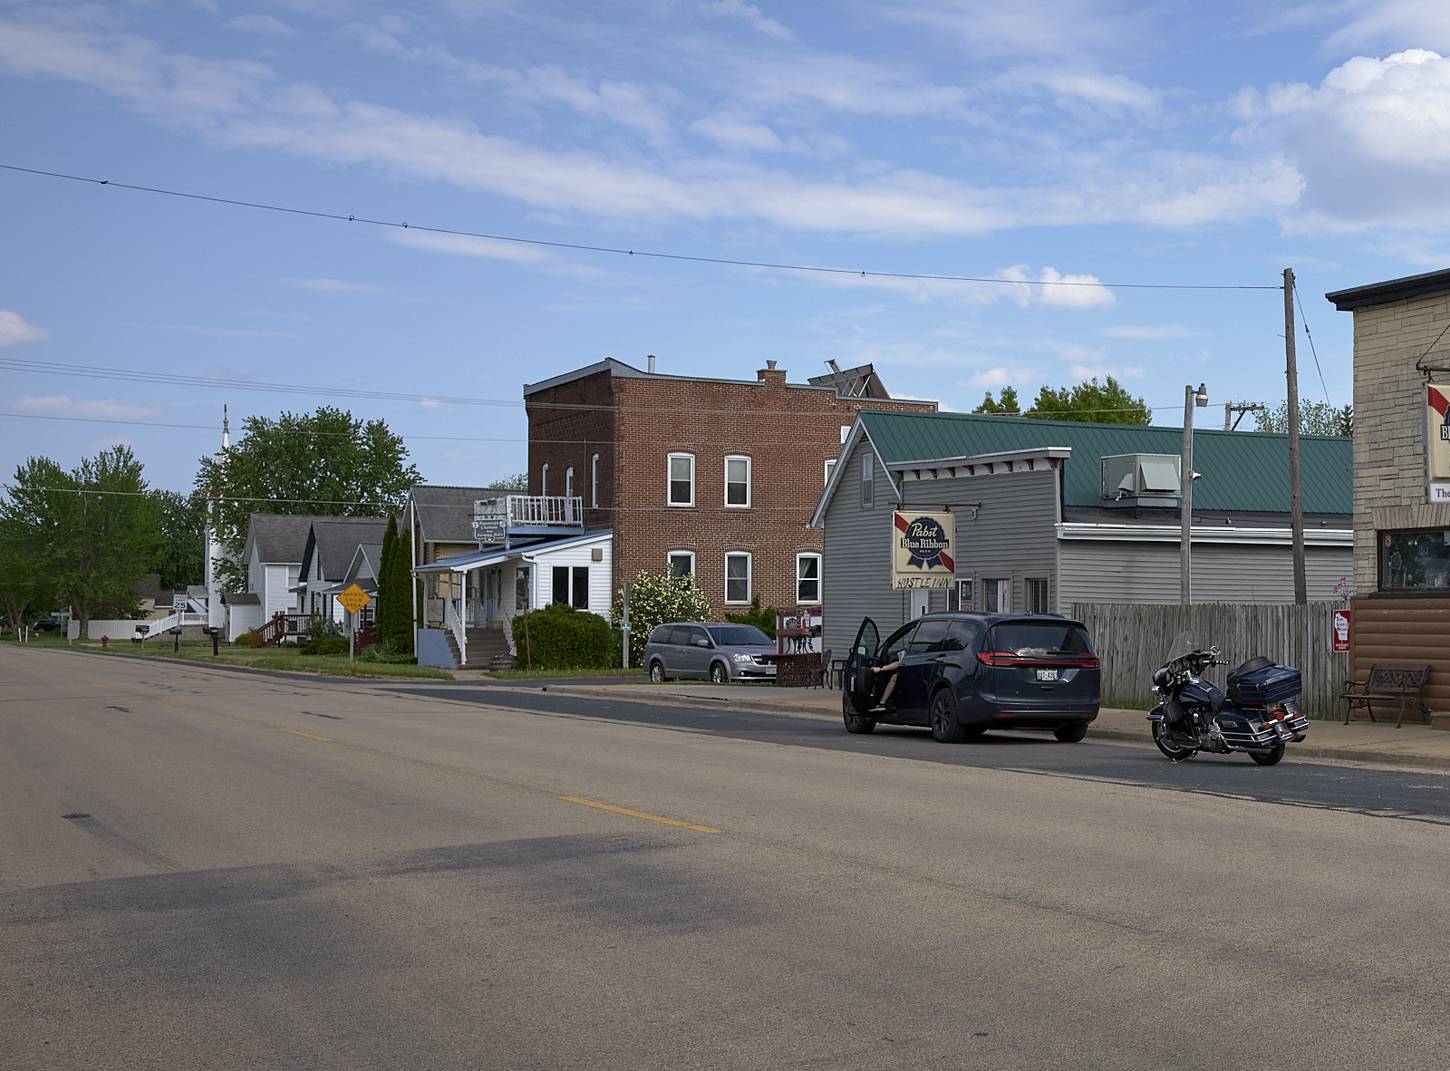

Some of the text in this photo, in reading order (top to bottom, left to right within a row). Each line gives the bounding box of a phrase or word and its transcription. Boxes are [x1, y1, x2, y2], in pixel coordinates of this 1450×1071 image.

[1435, 488, 1450, 498] The
[911, 523, 938, 538] Pabst
[901, 538, 949, 549] Blue Ribbon
